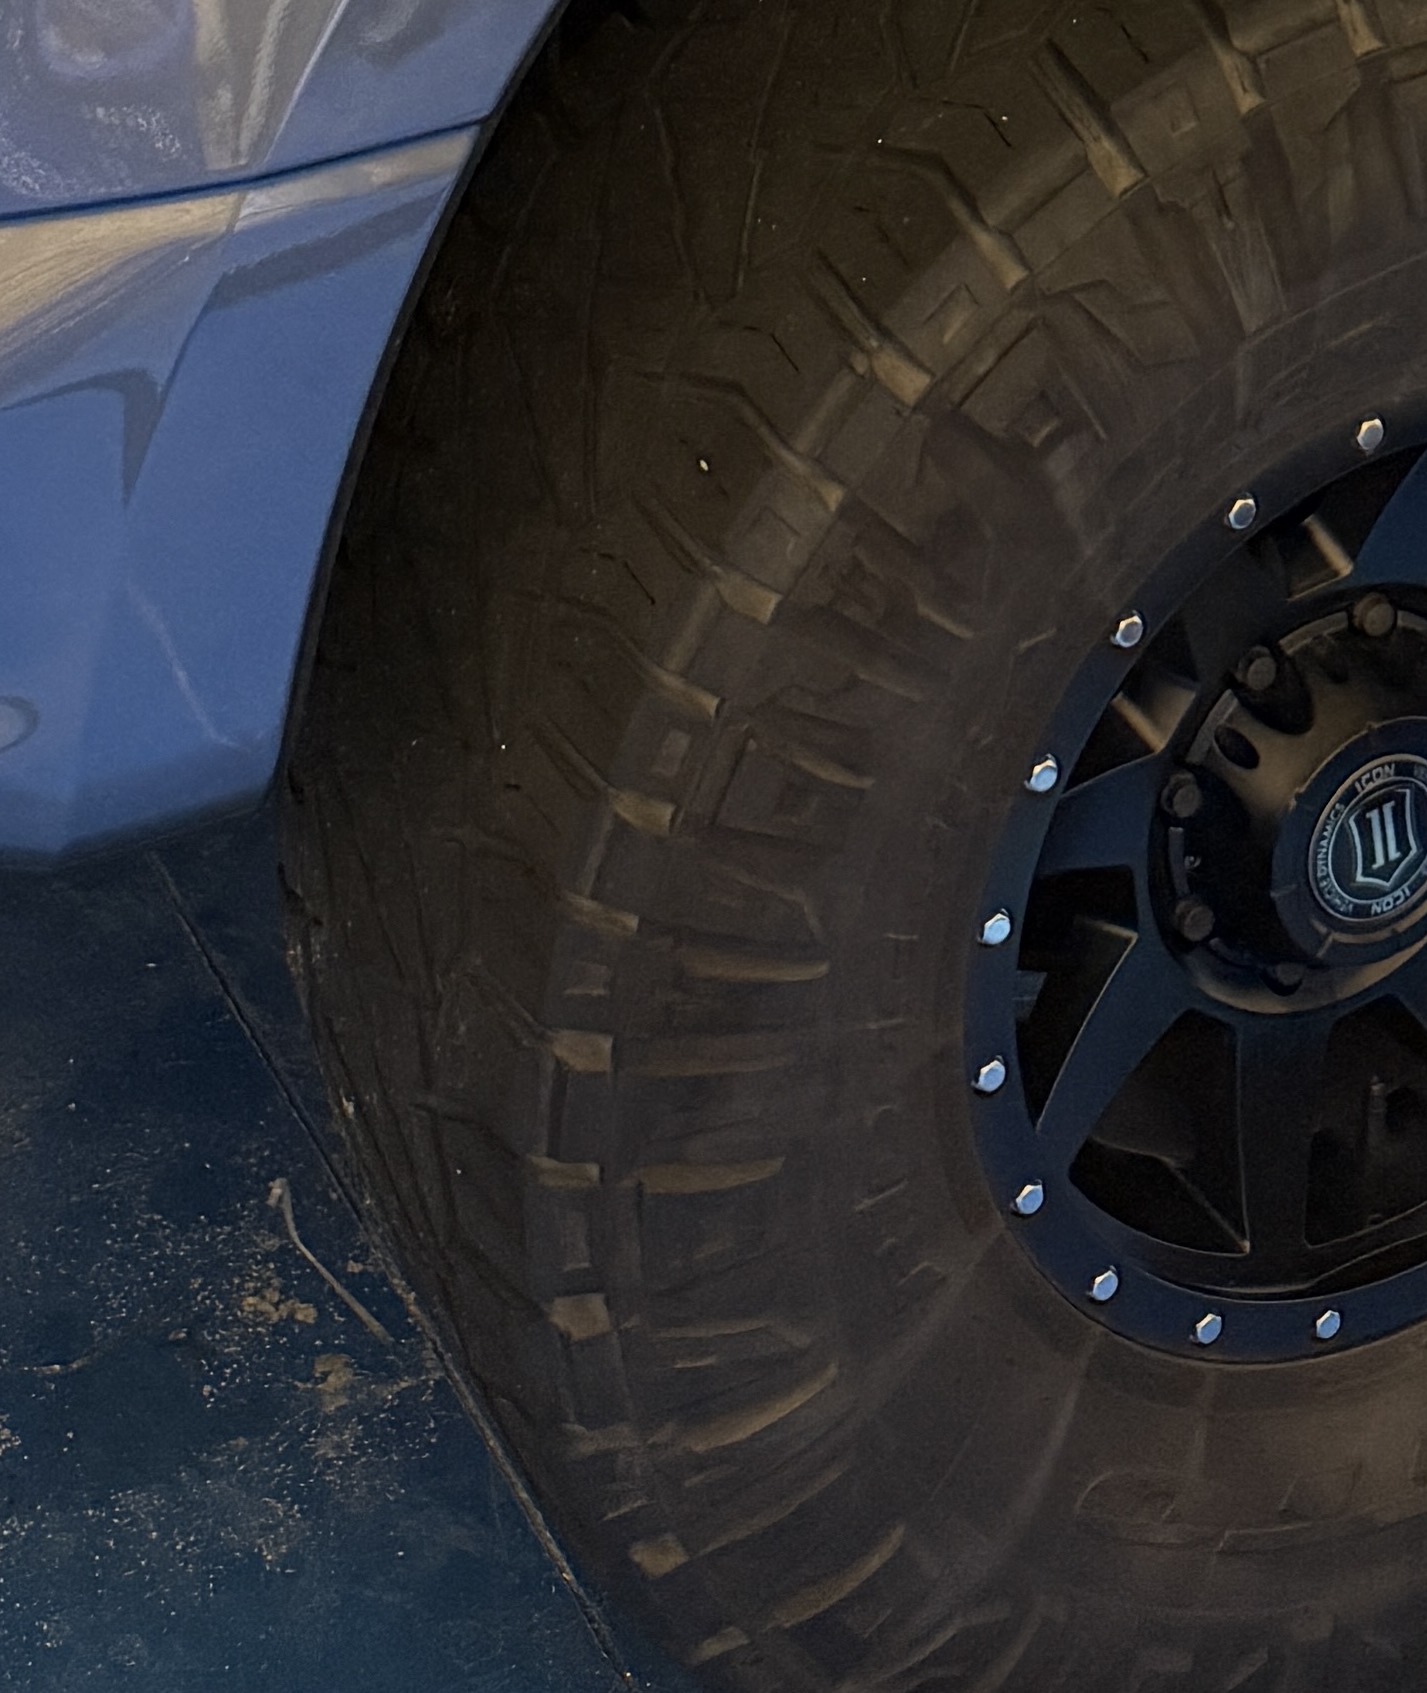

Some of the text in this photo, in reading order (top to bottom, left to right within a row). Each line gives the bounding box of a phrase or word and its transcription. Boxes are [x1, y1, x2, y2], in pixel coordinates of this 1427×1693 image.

[1354, 763, 1396, 794] ICON
[1316, 802, 1346, 878] DYNAMICS
[1370, 884, 1412, 915] ICON
